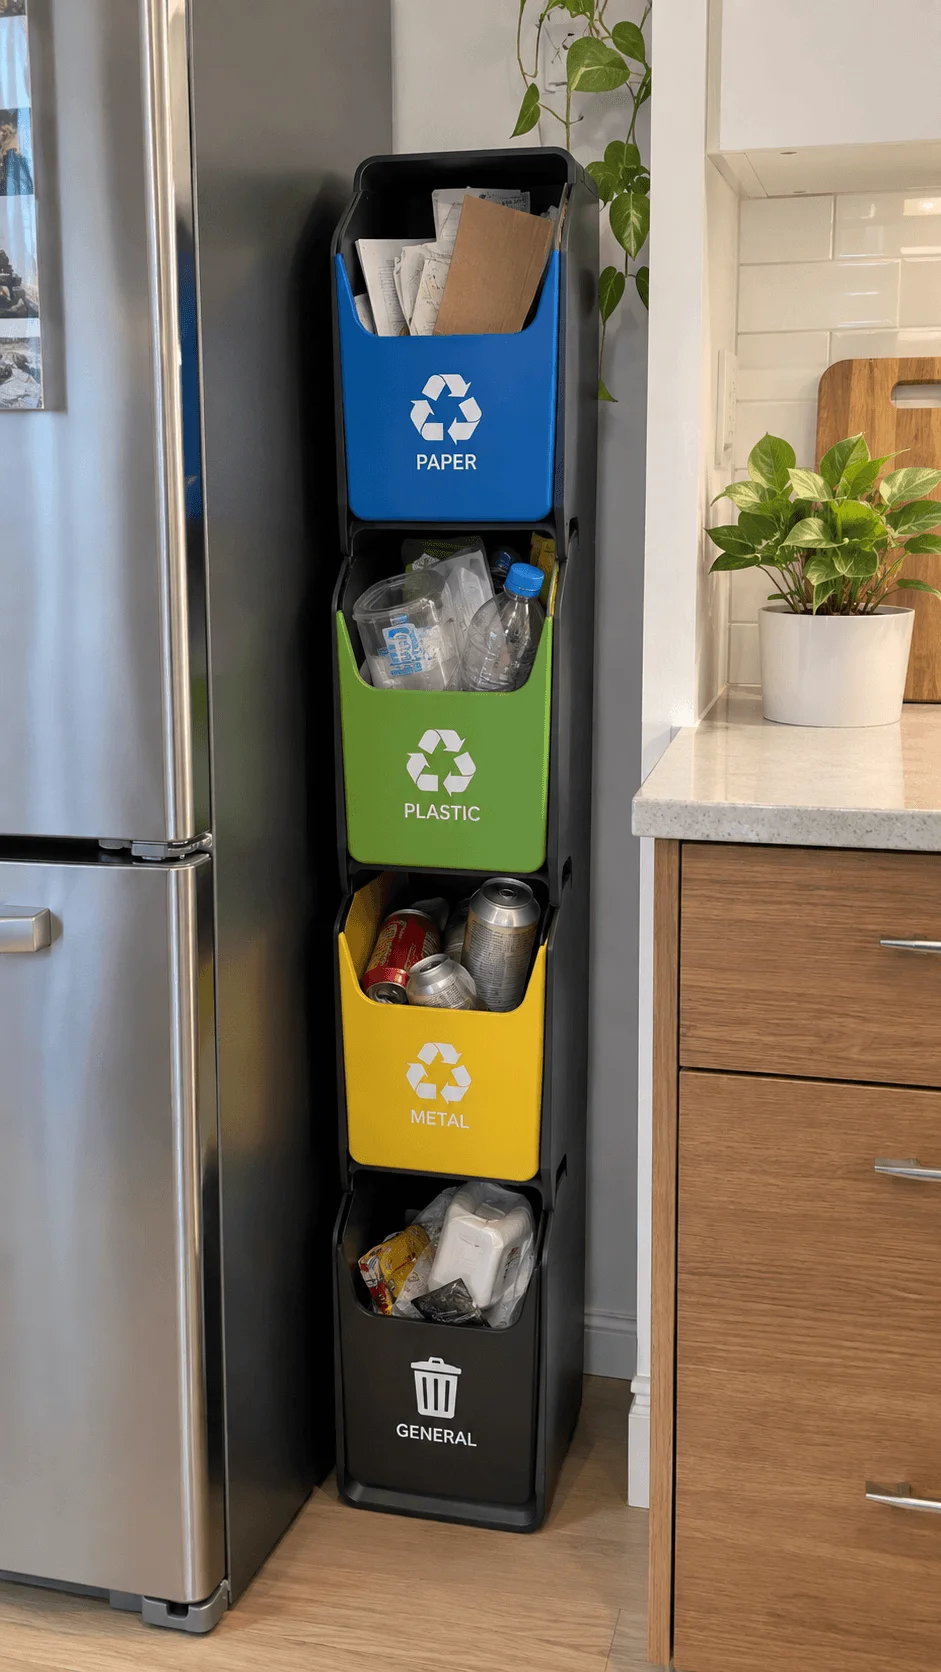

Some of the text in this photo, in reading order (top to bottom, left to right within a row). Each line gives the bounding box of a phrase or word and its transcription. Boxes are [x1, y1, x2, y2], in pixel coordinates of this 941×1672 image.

[416, 453, 477, 470] PAPER
[404, 803, 480, 822] PLASTIC
[410, 1109, 470, 1129] METAL
[396, 1423, 477, 1447] GENERAL
